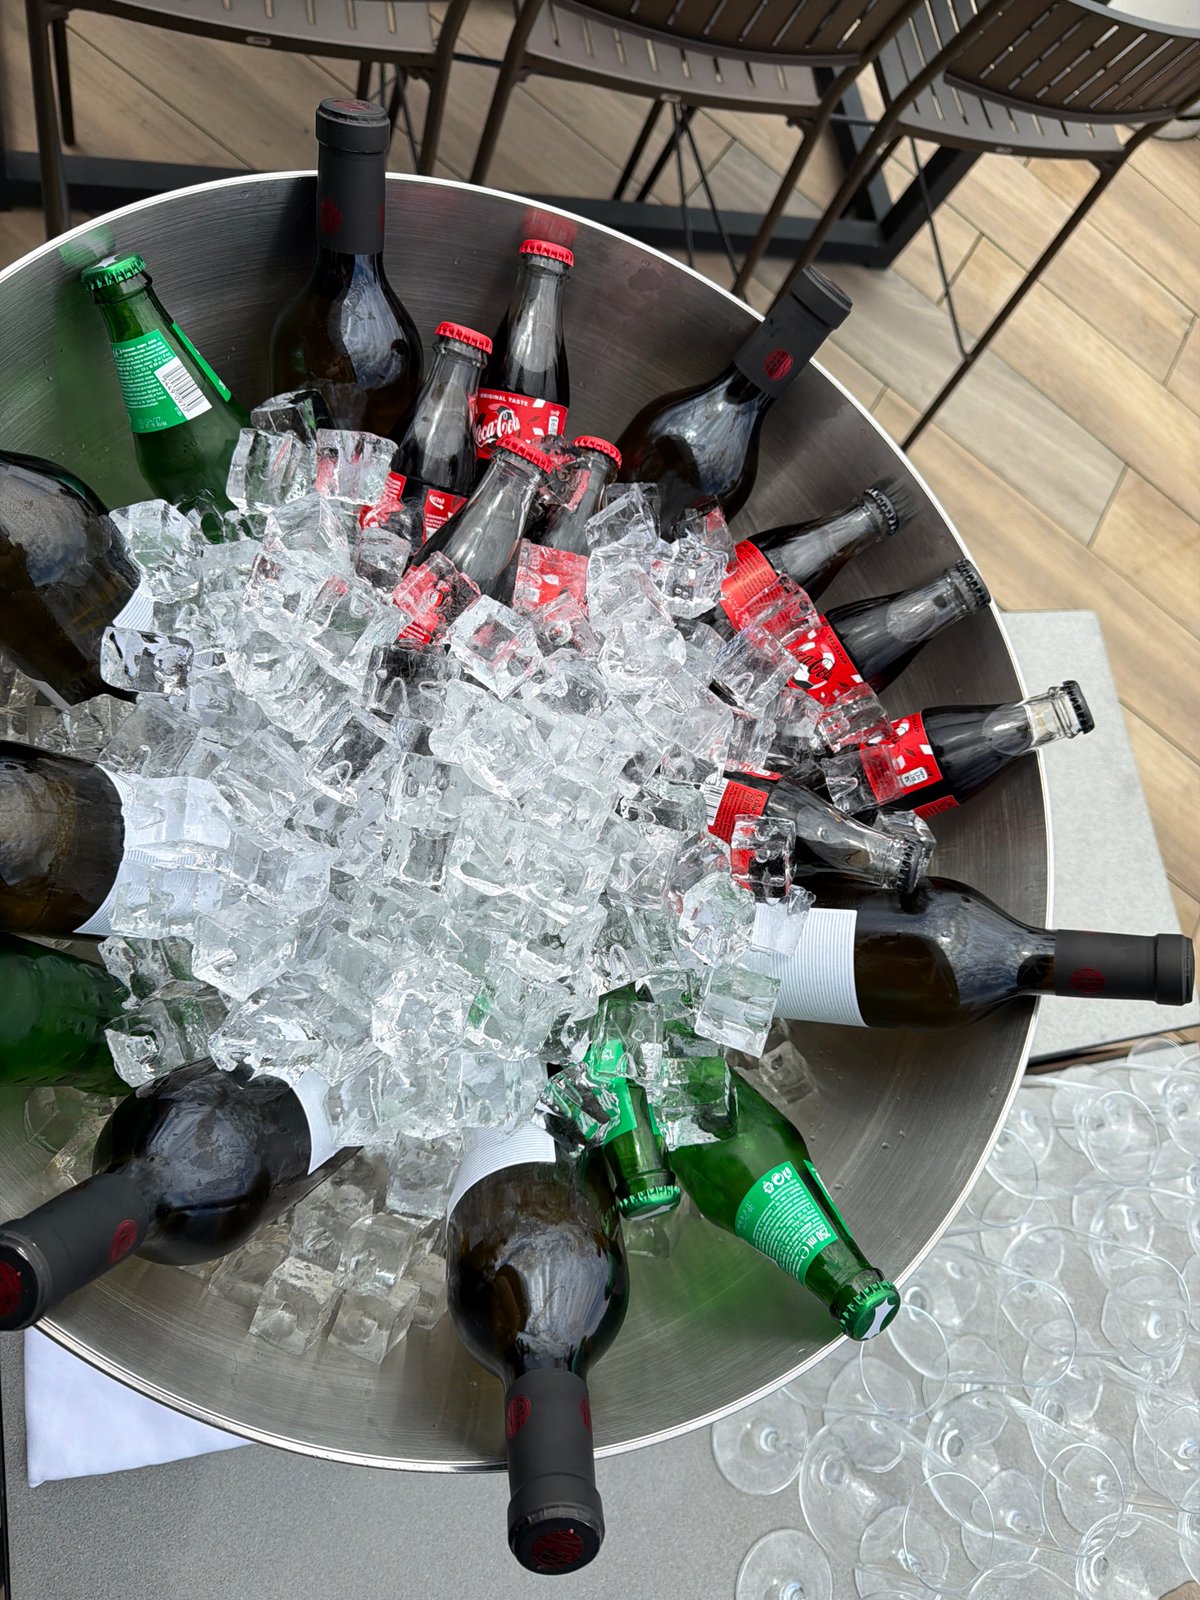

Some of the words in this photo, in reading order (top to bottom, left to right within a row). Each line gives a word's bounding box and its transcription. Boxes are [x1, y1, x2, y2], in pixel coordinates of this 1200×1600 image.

[480, 393, 506, 402] ORIGINAL
[508, 397, 529, 407] TASTE
[475, 409, 520, 442] oca-Cola
[816, 1227, 831, 1242] 250
[806, 1235, 817, 1249] ml
